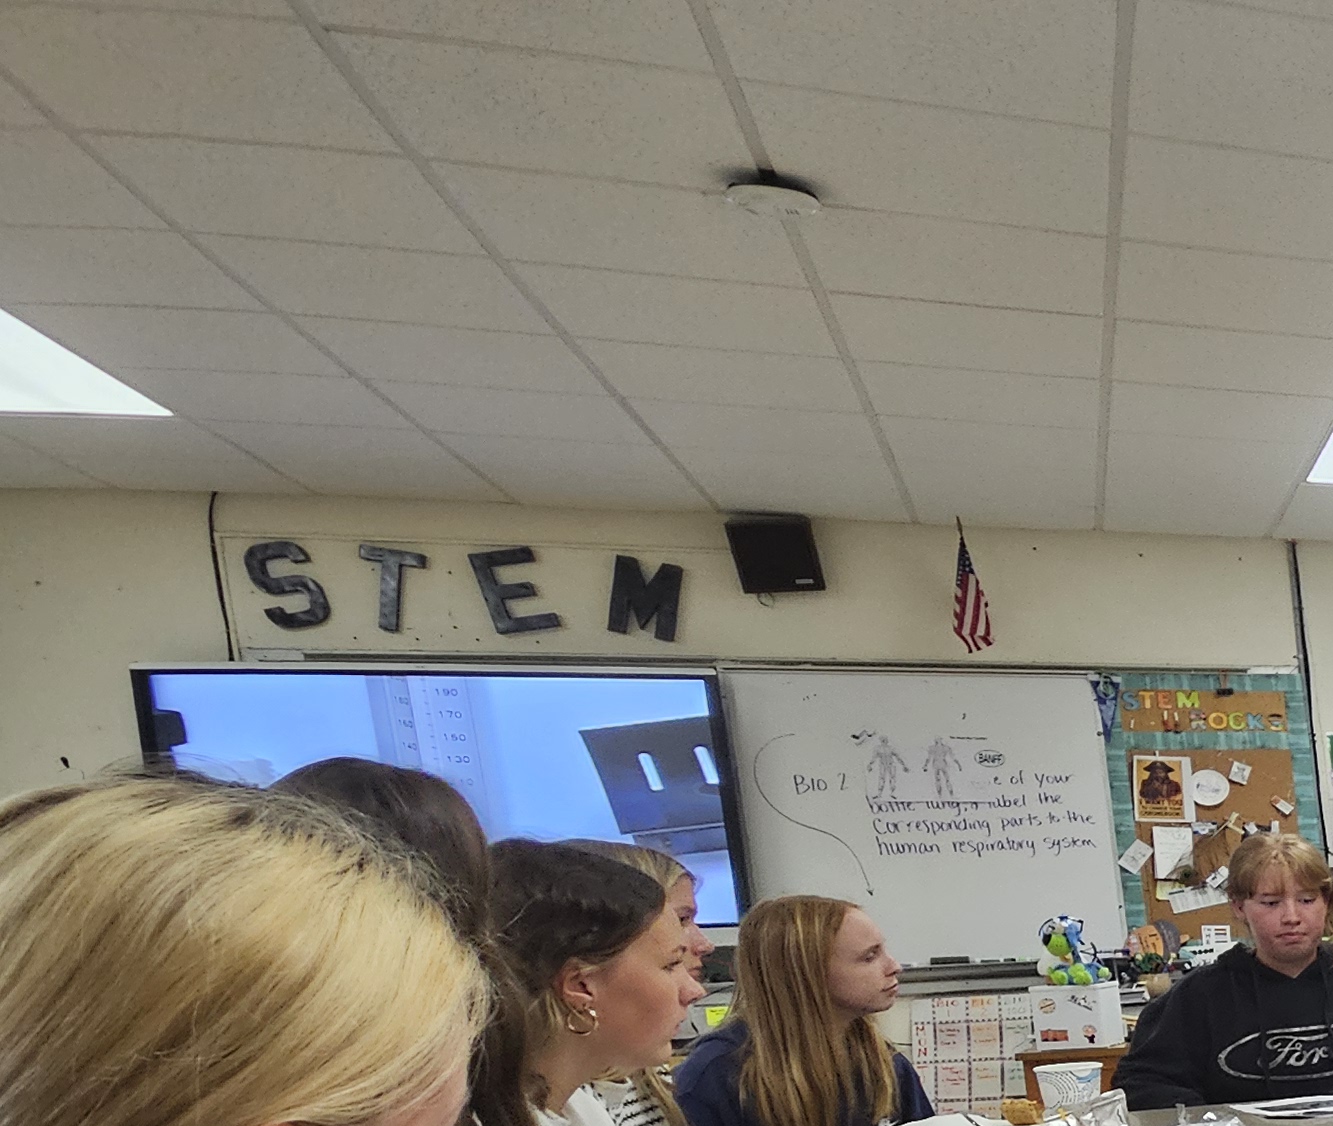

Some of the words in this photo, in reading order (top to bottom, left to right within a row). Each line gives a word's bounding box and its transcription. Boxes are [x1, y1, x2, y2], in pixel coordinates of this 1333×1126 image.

[244, 541, 684, 642] STEM
[435, 688, 458, 697] 190
[1122, 690, 1199, 710] STEM
[439, 710, 462, 719] 170
[447, 755, 470, 763] 130
[794, 774, 828, 794] BIO
[1010, 770, 1023, 784] of
[1035, 772, 1073, 788] your
[1038, 792, 1062, 804] the
[873, 818, 991, 837] Corresponding
[1001, 814, 1042, 831] parts
[1046, 812, 1060, 824] to
[1067, 810, 1096, 824] the
[876, 836, 940, 856] human
[952, 837, 1035, 857] respiratory
[1043, 836, 1097, 856] system
